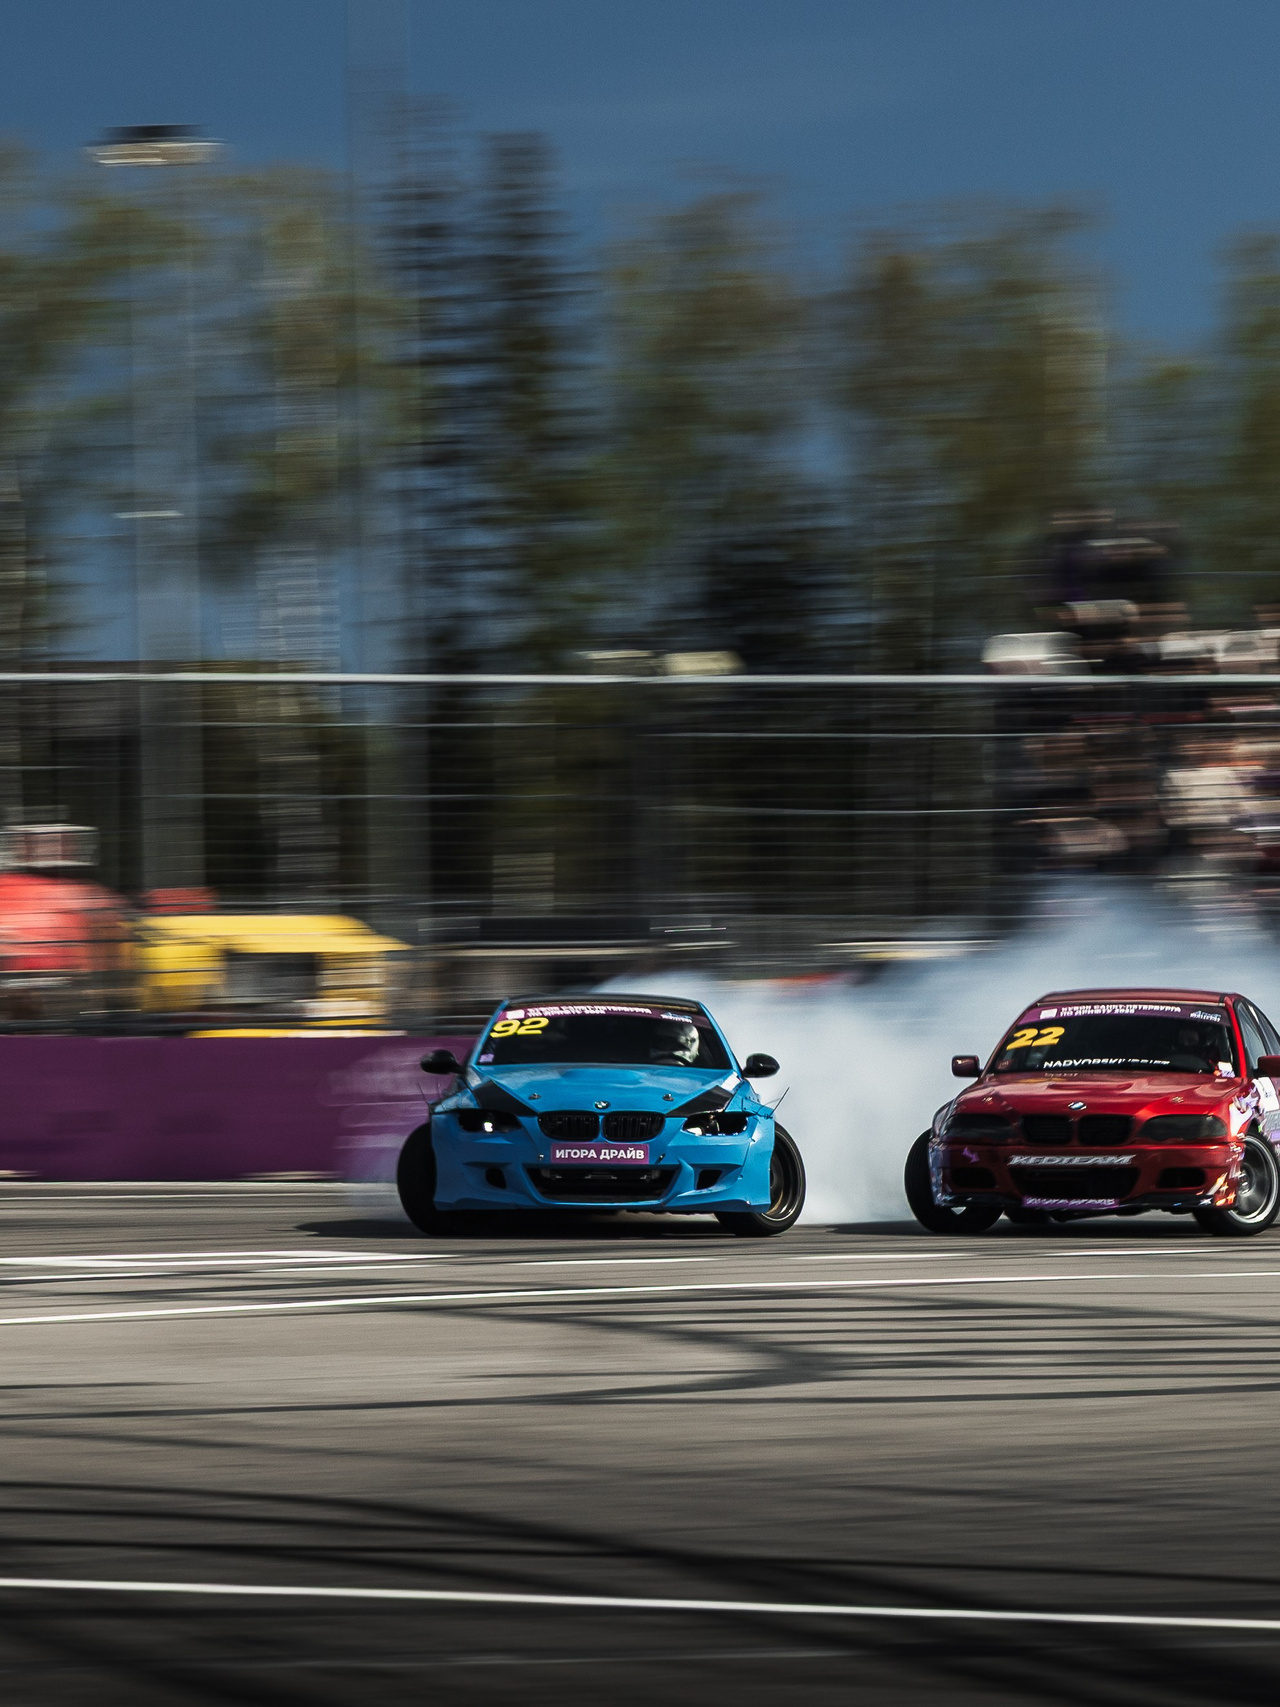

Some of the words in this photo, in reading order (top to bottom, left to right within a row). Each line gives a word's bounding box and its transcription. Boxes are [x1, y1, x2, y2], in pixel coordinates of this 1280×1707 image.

[489, 1017, 549, 1038] 92
[1006, 1026, 1065, 1050] 22
[555, 1149, 596, 1159] ИГОРА
[599, 1147, 645, 1160] ДРАЙВ
